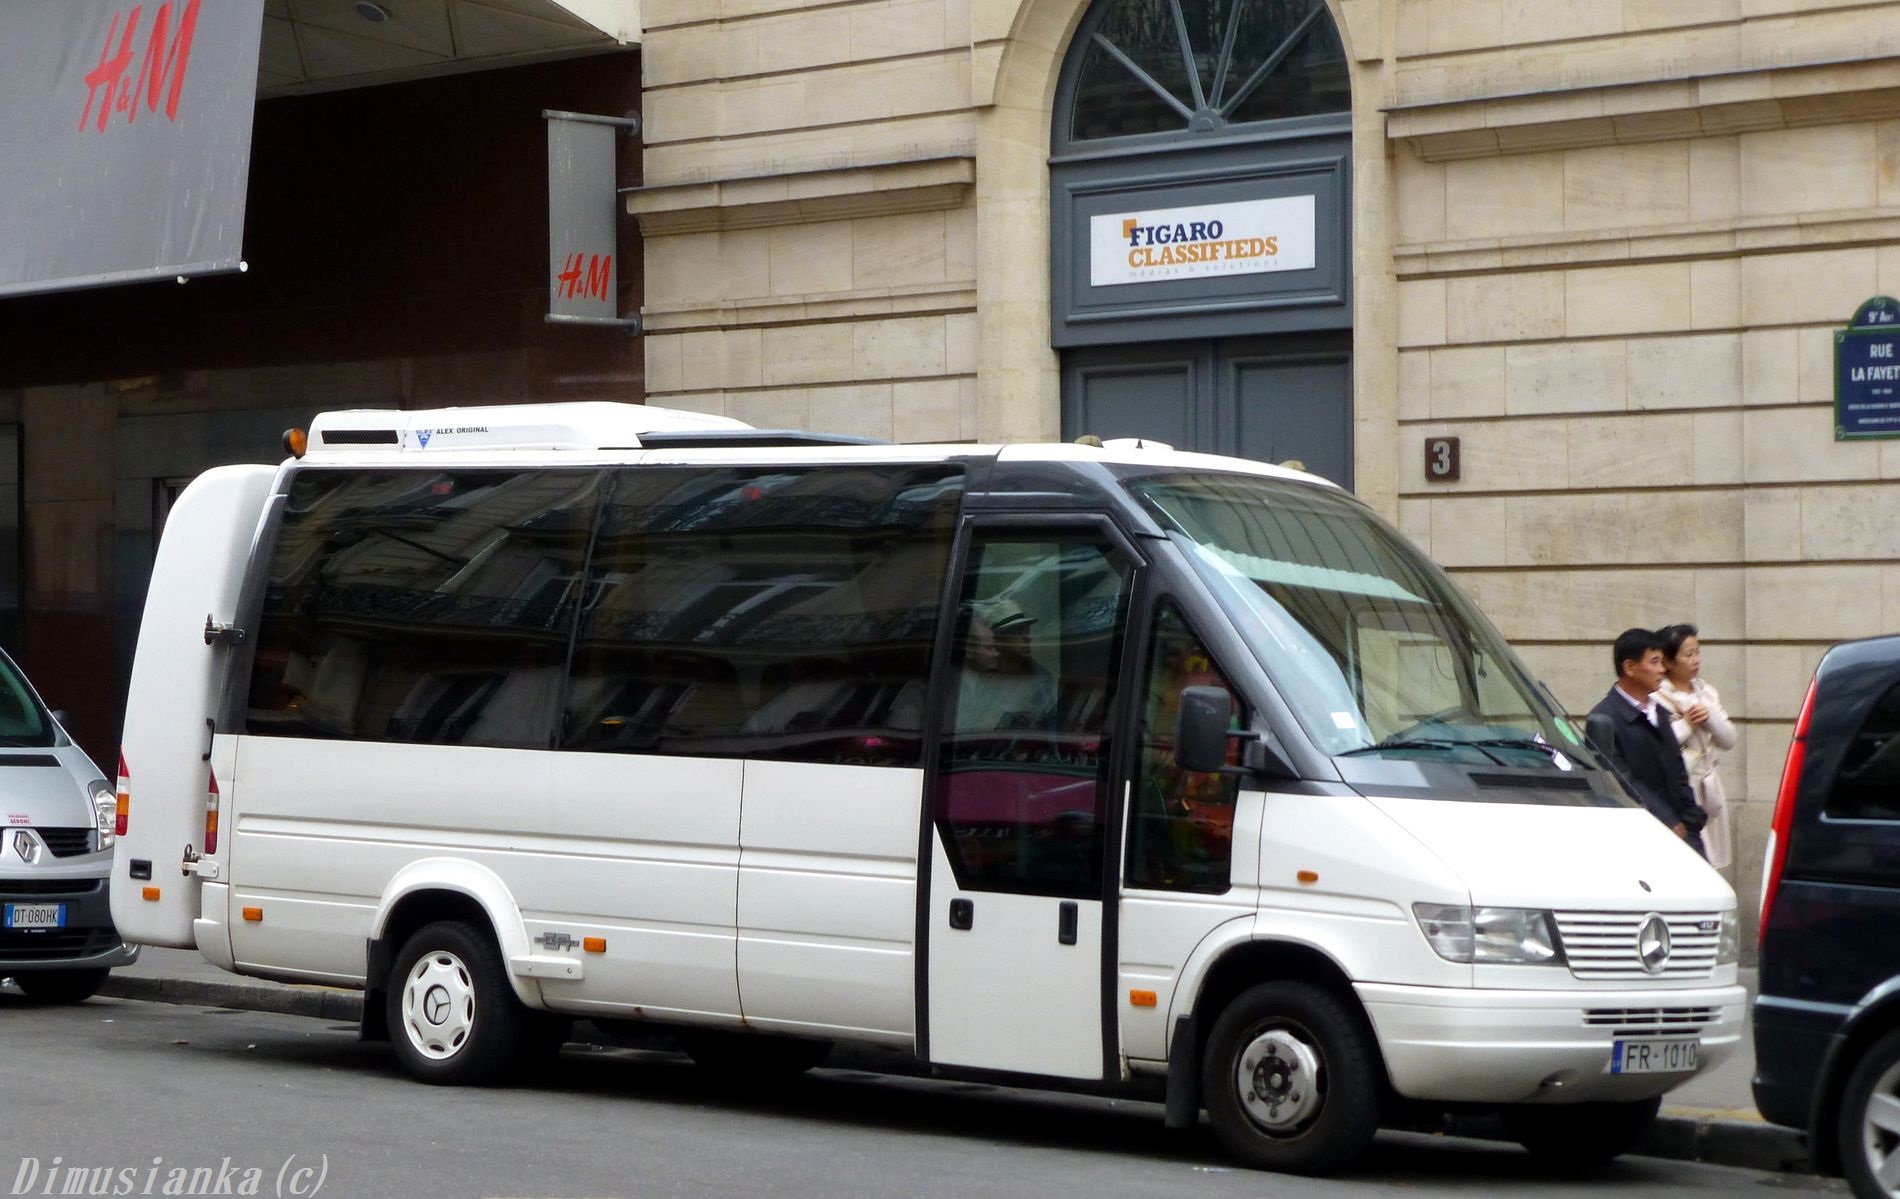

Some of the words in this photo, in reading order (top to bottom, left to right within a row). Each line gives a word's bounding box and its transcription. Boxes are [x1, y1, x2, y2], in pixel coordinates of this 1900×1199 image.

[79, 0, 201, 134] H&M
[1129, 220, 1223, 247] FIGARO
[1128, 236, 1278, 268] CLASSIFIEDS
[1205, 259, 1278, 271] solutions
[558, 252, 611, 302] H&M
[1870, 343, 1893, 358] RUE
[1851, 367, 1865, 381] LA
[456, 426, 489, 434] ORIGINAL
[1432, 441, 1450, 475] 3
[1626, 1043, 1696, 1069] FR-1010
